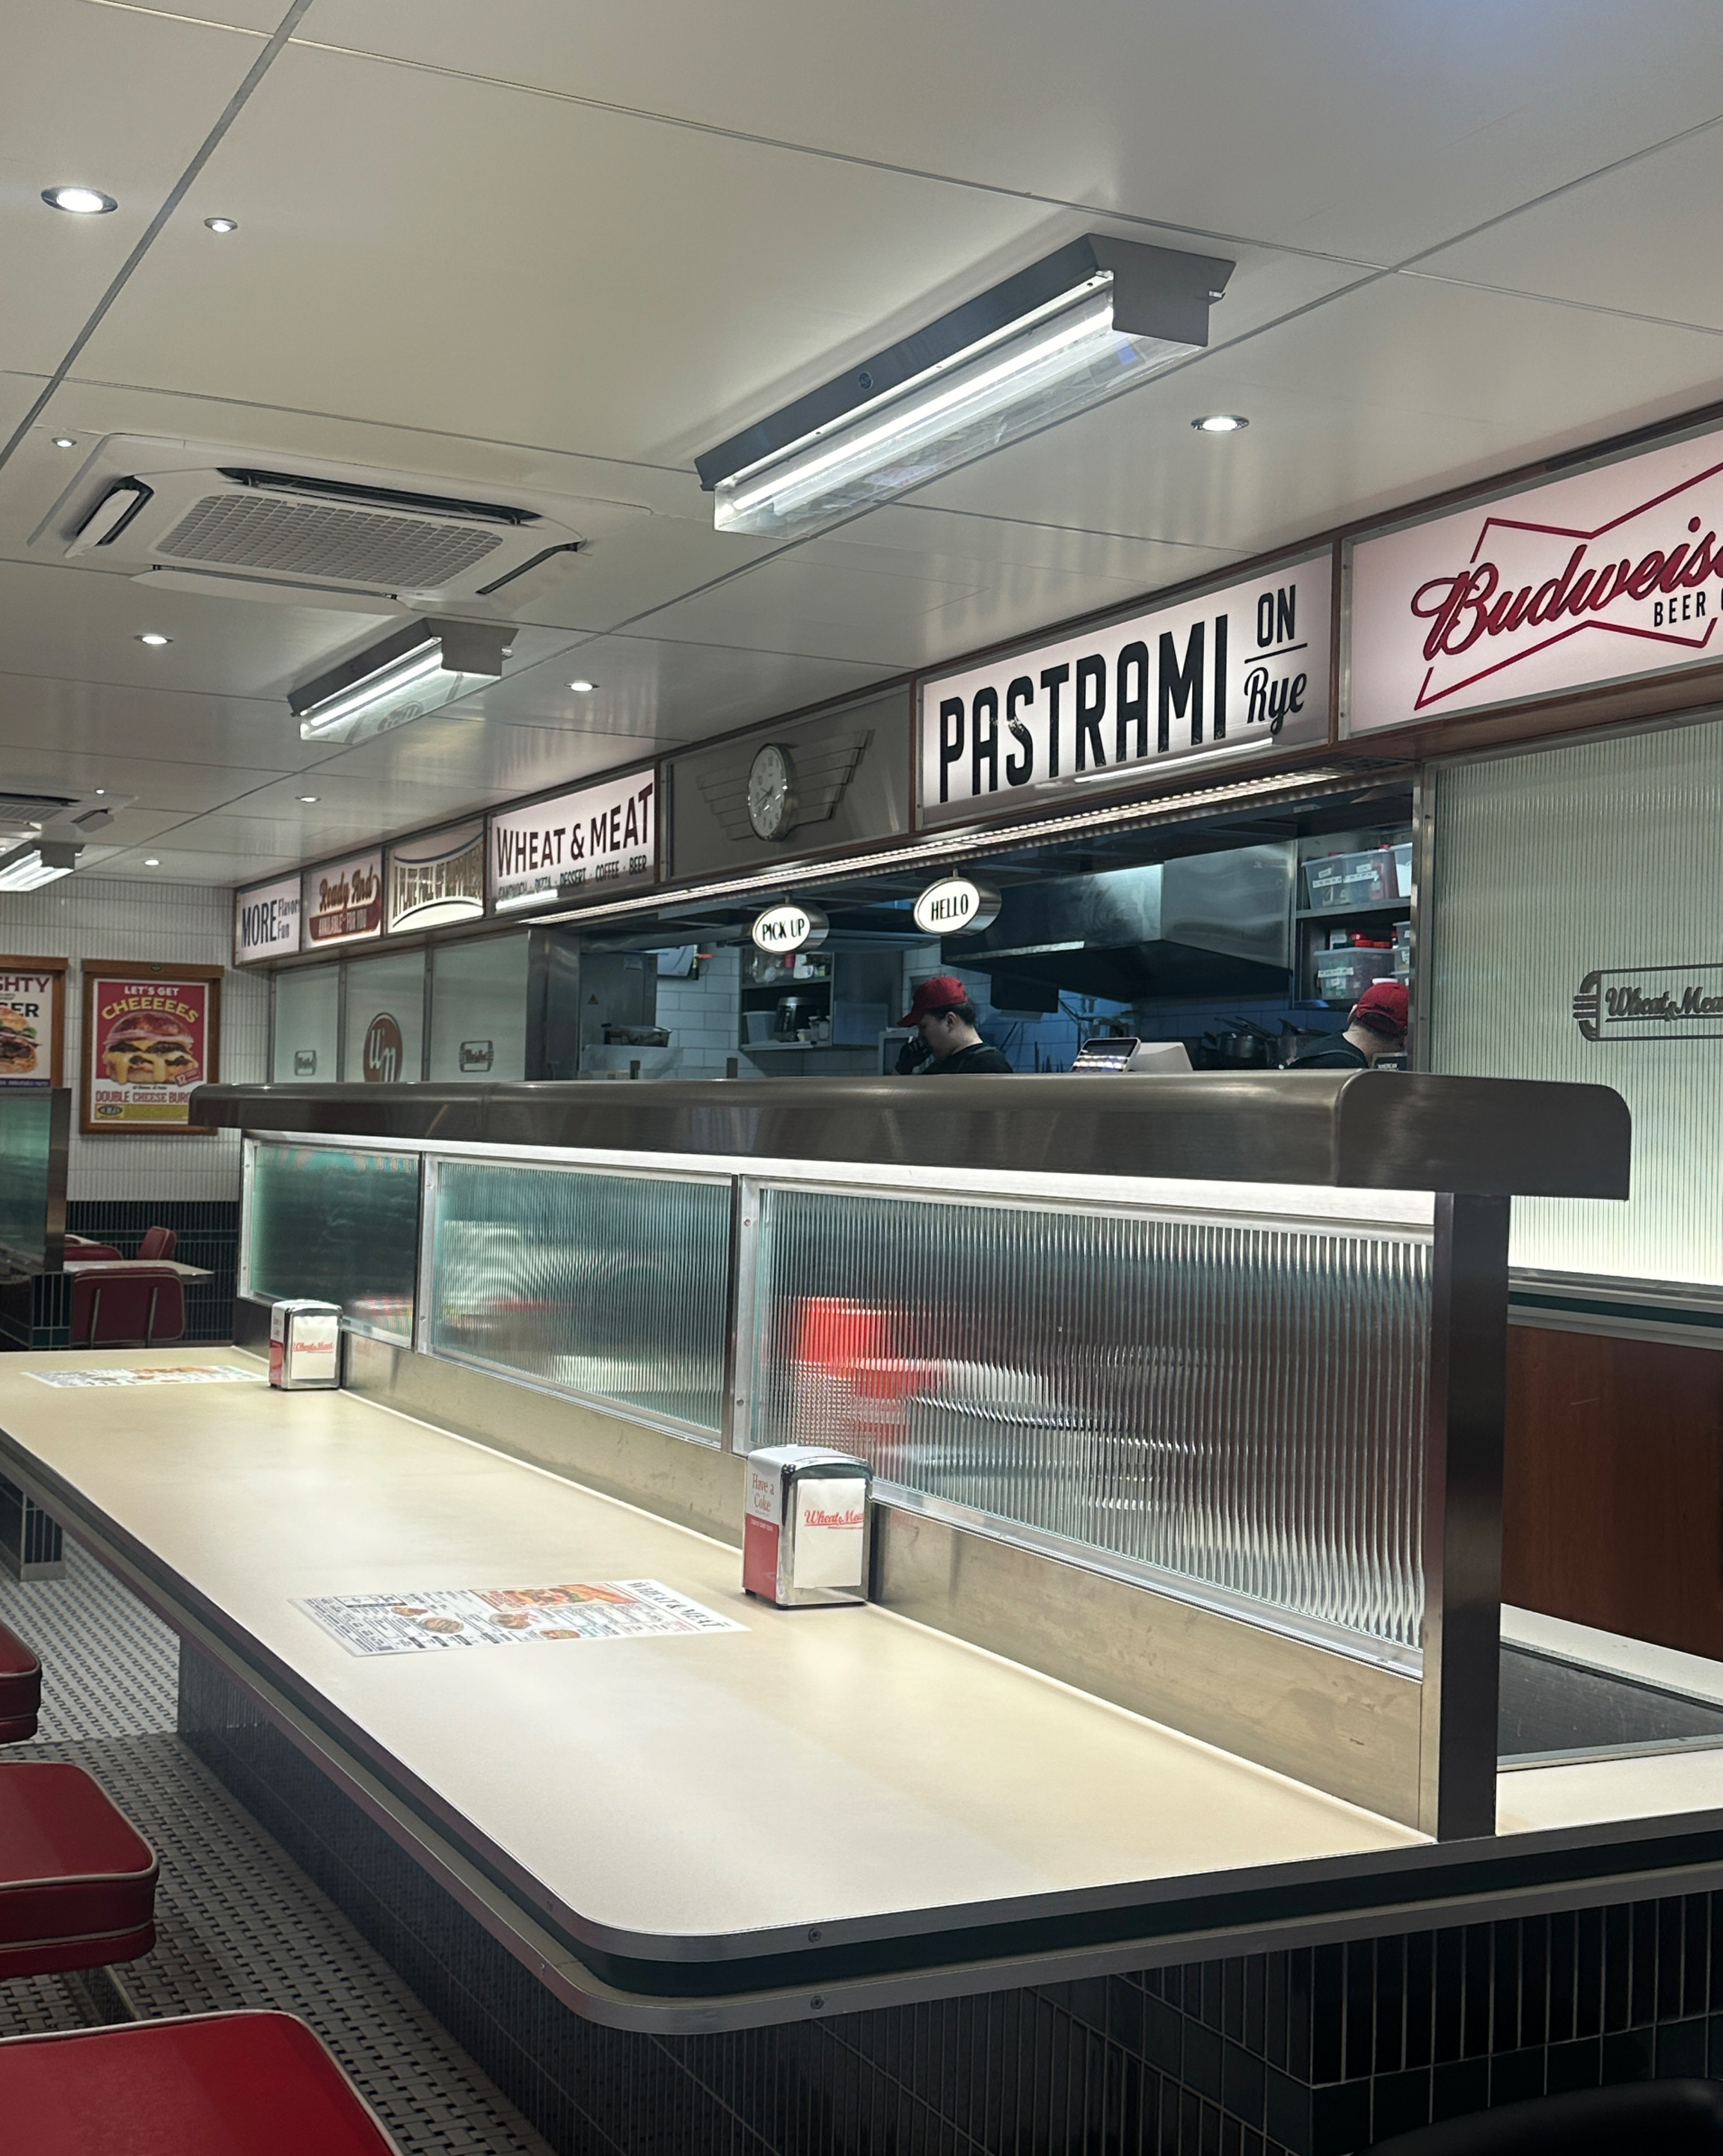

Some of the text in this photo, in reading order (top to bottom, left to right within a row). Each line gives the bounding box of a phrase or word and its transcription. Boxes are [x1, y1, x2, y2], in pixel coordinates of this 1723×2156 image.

[1411, 516, 1723, 660] Budweis
[1257, 585, 1297, 648] ON
[1654, 591, 1706, 627] BEER
[940, 614, 1228, 803] PASTRAMI
[1244, 667, 1307, 736] Rye
[497, 782, 653, 877] WHEAT & MEAT
[560, 867, 586, 886] DESSERT
[595, 861, 619, 882] COFFEE
[629, 855, 647, 875] BEER
[931, 894, 968, 921] HELLO
[242, 900, 277, 948] MORE
[762, 918, 805, 942] PICK UP
[0, 976, 50, 993] HTY
[124, 986, 179, 996] LET'S GET
[0, 1002, 39, 1017] ER
[102, 997, 199, 1023] CHEEEEES
[96, 1090, 130, 1103] DOUBLE
[132, 1092, 167, 1103] CHEESE
[752, 1473, 775, 1495] Have a
[754, 1493, 771, 1512] Coke
